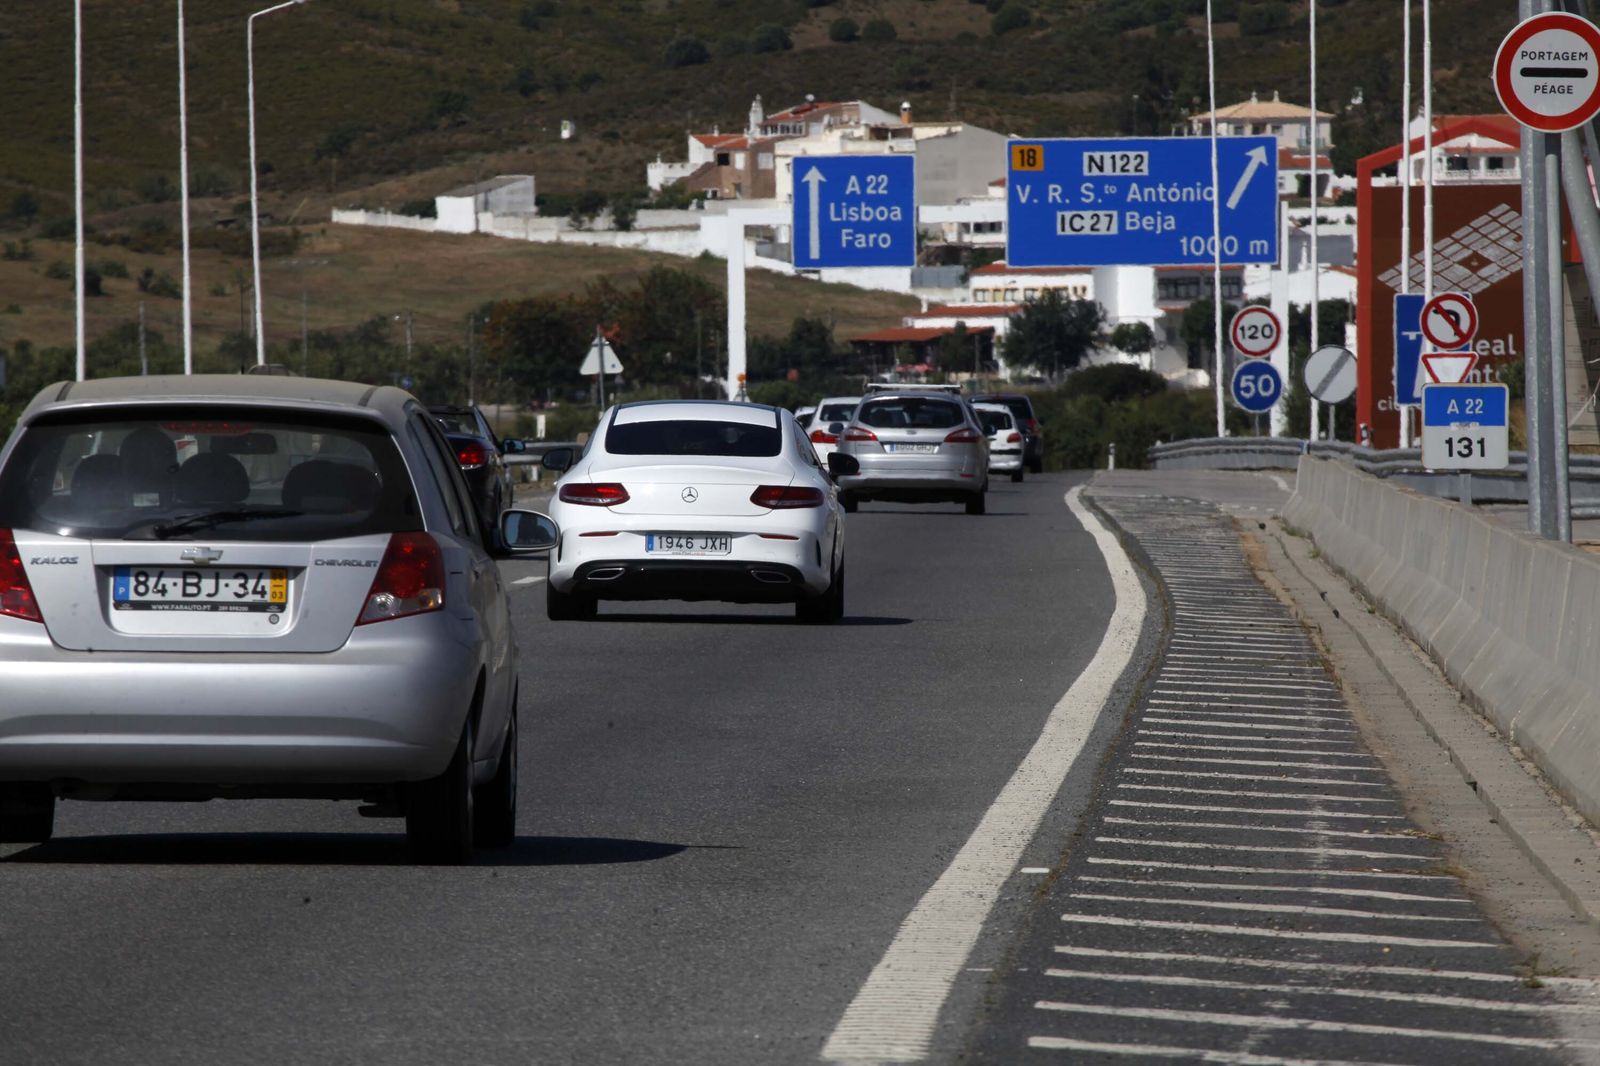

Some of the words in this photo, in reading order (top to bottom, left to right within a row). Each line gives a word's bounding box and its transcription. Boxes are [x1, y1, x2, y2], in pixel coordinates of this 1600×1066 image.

[1521, 50, 1588, 61] PORTAGEM
[1534, 82, 1574, 95] PÉAGE
[1019, 148, 1037, 168] 18
[845, 174, 861, 195] A
[866, 174, 888, 195] 22
[1016, 184, 1039, 204] V.
[1048, 184, 1070, 204] R.
[1126, 182, 1215, 203] António
[829, 202, 902, 222] Lisboa
[1125, 210, 1176, 235] Beja
[841, 228, 892, 249] Faro
[1179, 235, 1239, 257] 1000
[1249, 239, 1270, 255] m
[1239, 324, 1274, 340] 120
[1240, 374, 1275, 399] 50
[1447, 399, 1460, 415] A
[1465, 398, 1484, 415] 22
[1445, 436, 1486, 458] 131
[659, 536, 694, 549] 1946
[700, 536, 728, 551] JXH
[30, 556, 79, 565] KALOS
[314, 559, 379, 567] CHEVROLET
